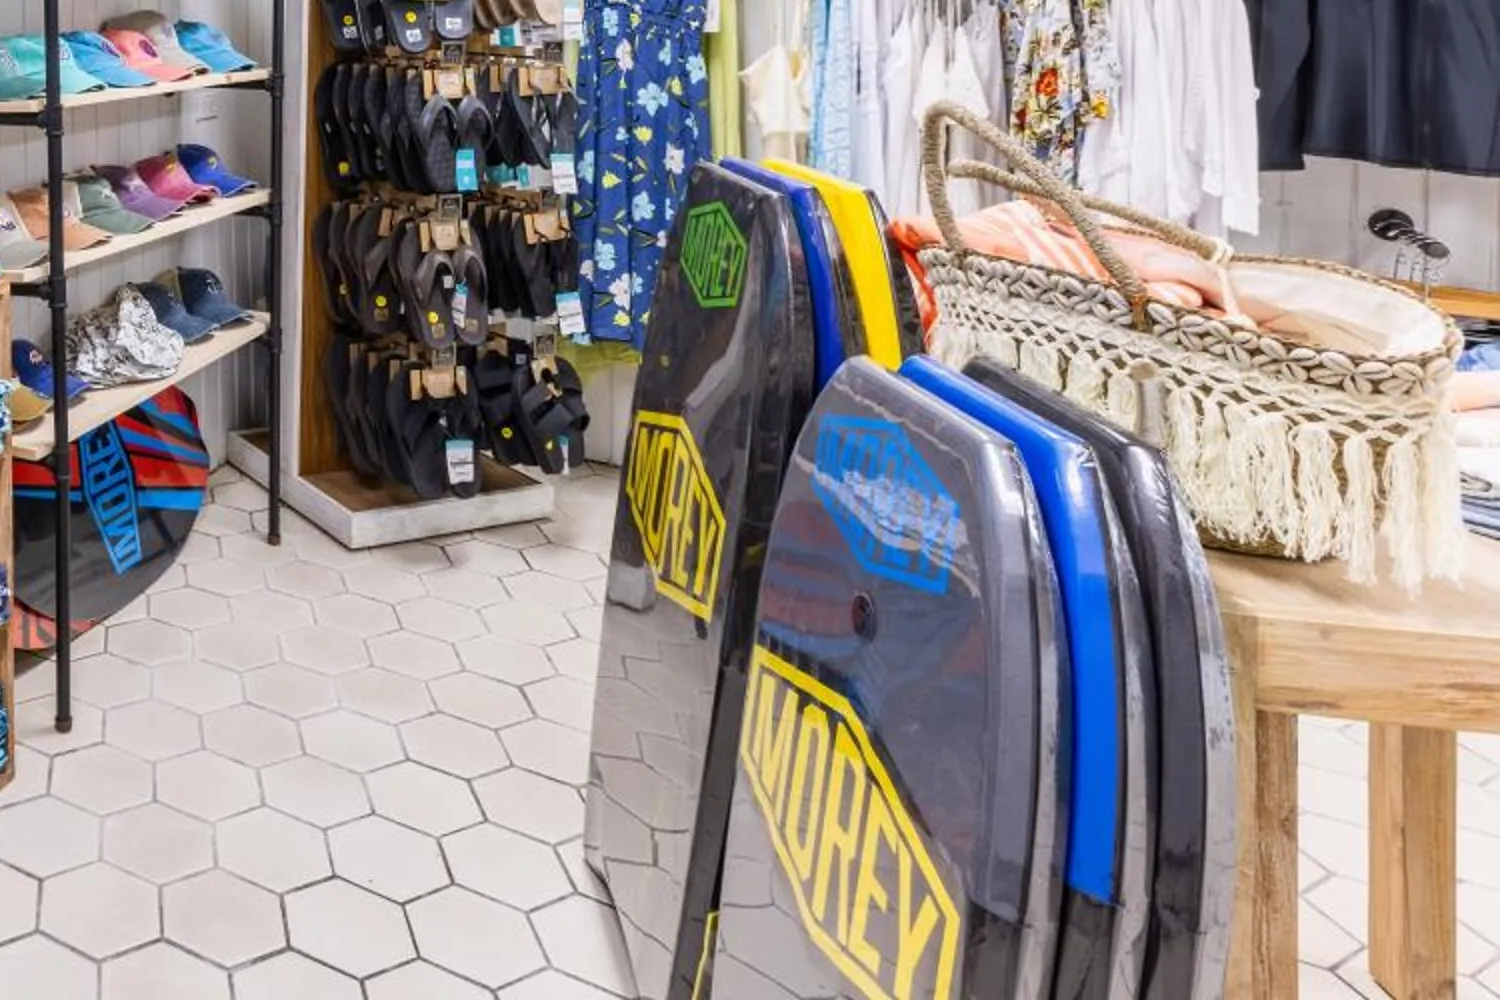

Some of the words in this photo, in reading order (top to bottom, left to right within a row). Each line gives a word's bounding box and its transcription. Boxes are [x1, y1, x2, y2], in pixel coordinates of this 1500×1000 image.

[83, 418, 141, 566] MORE
[633, 424, 718, 598] MOREY
[752, 671, 940, 1000] MOREY
